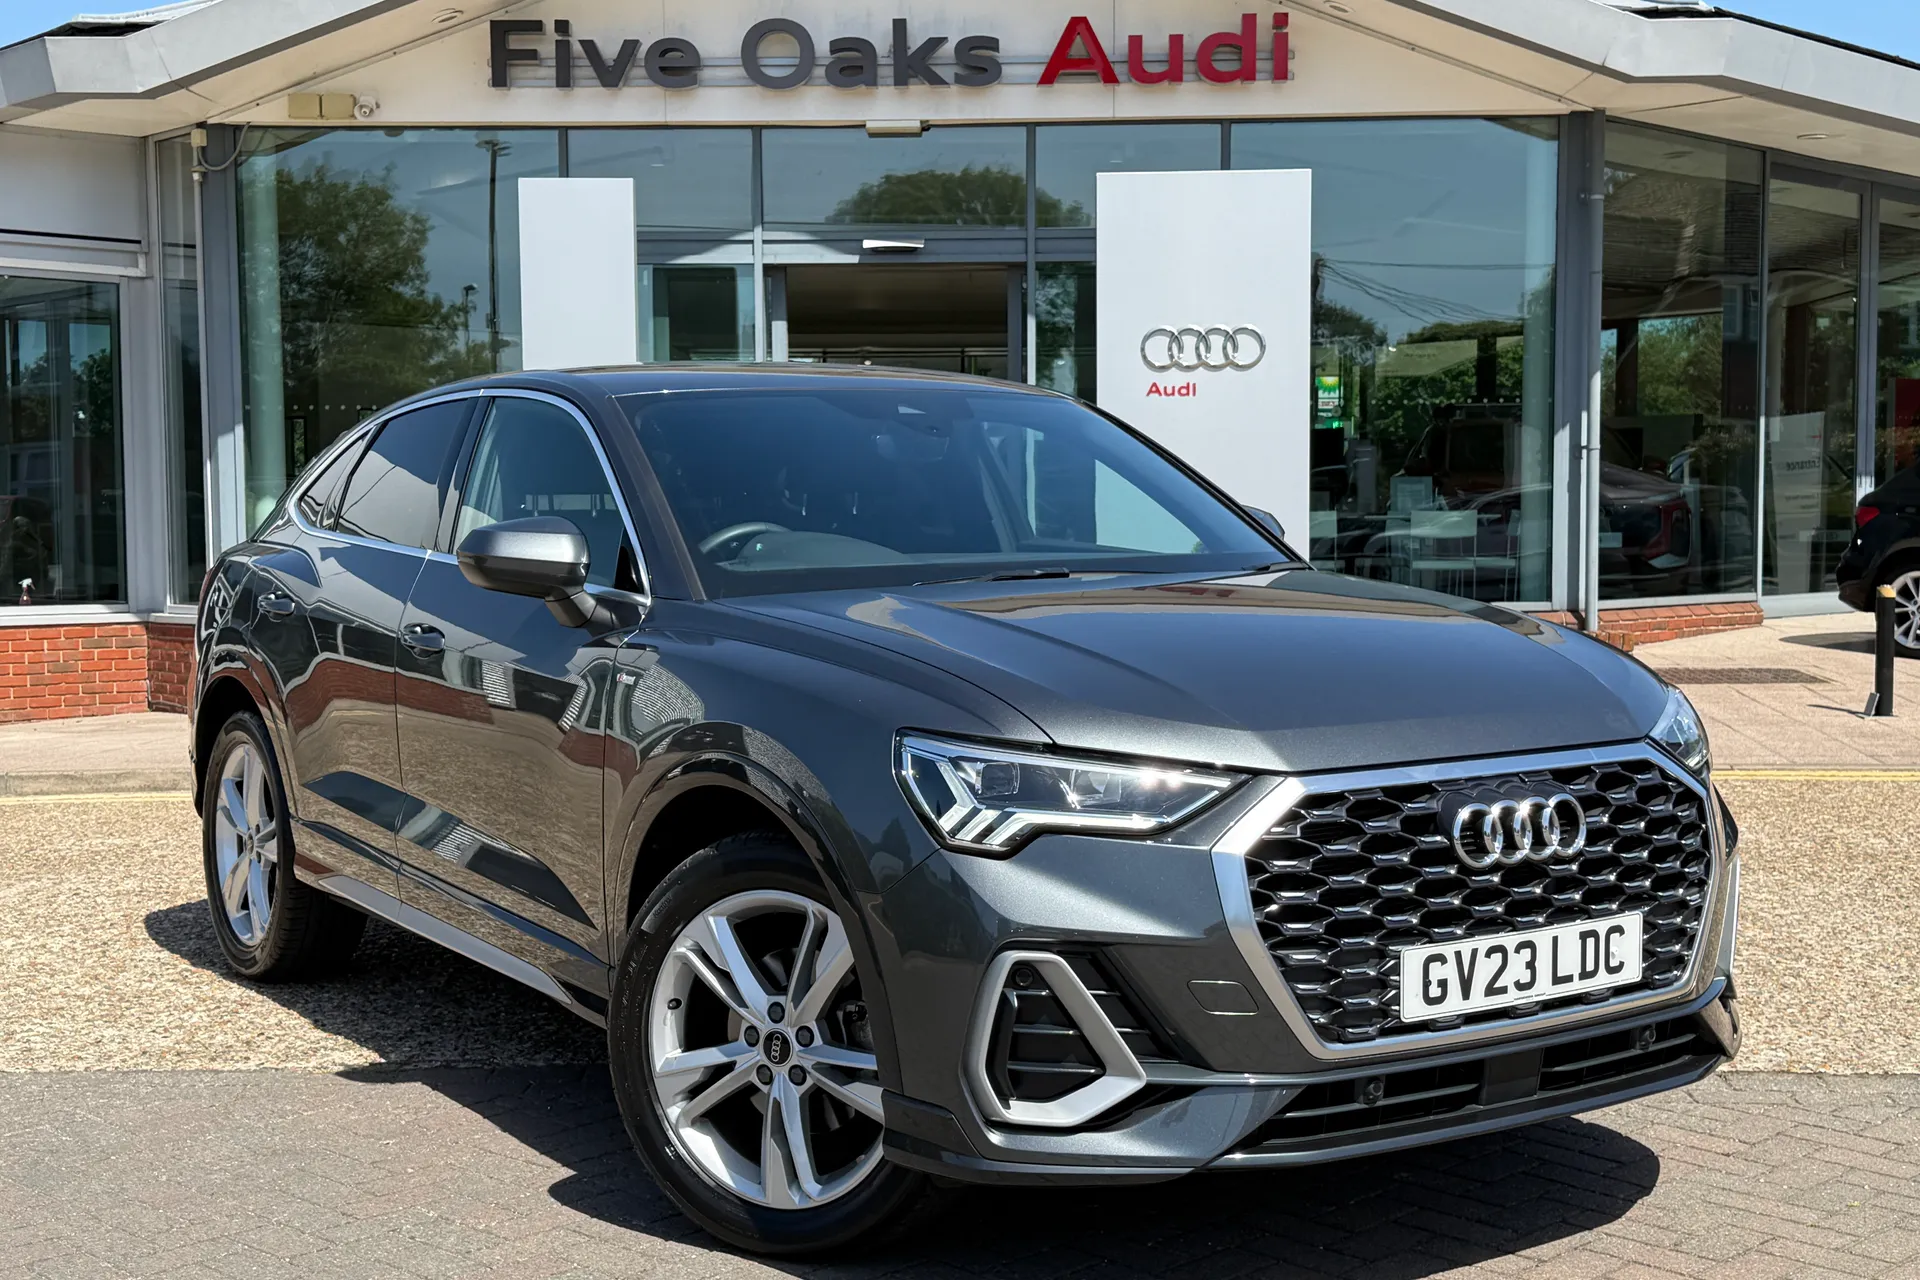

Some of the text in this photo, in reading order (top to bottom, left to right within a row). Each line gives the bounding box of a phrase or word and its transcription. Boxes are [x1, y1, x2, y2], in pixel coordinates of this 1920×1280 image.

[489, 12, 1290, 90] Five Oaks Audi
[1145, 381, 1197, 398] Audi
[1422, 924, 1626, 1006] GV23 LDC
